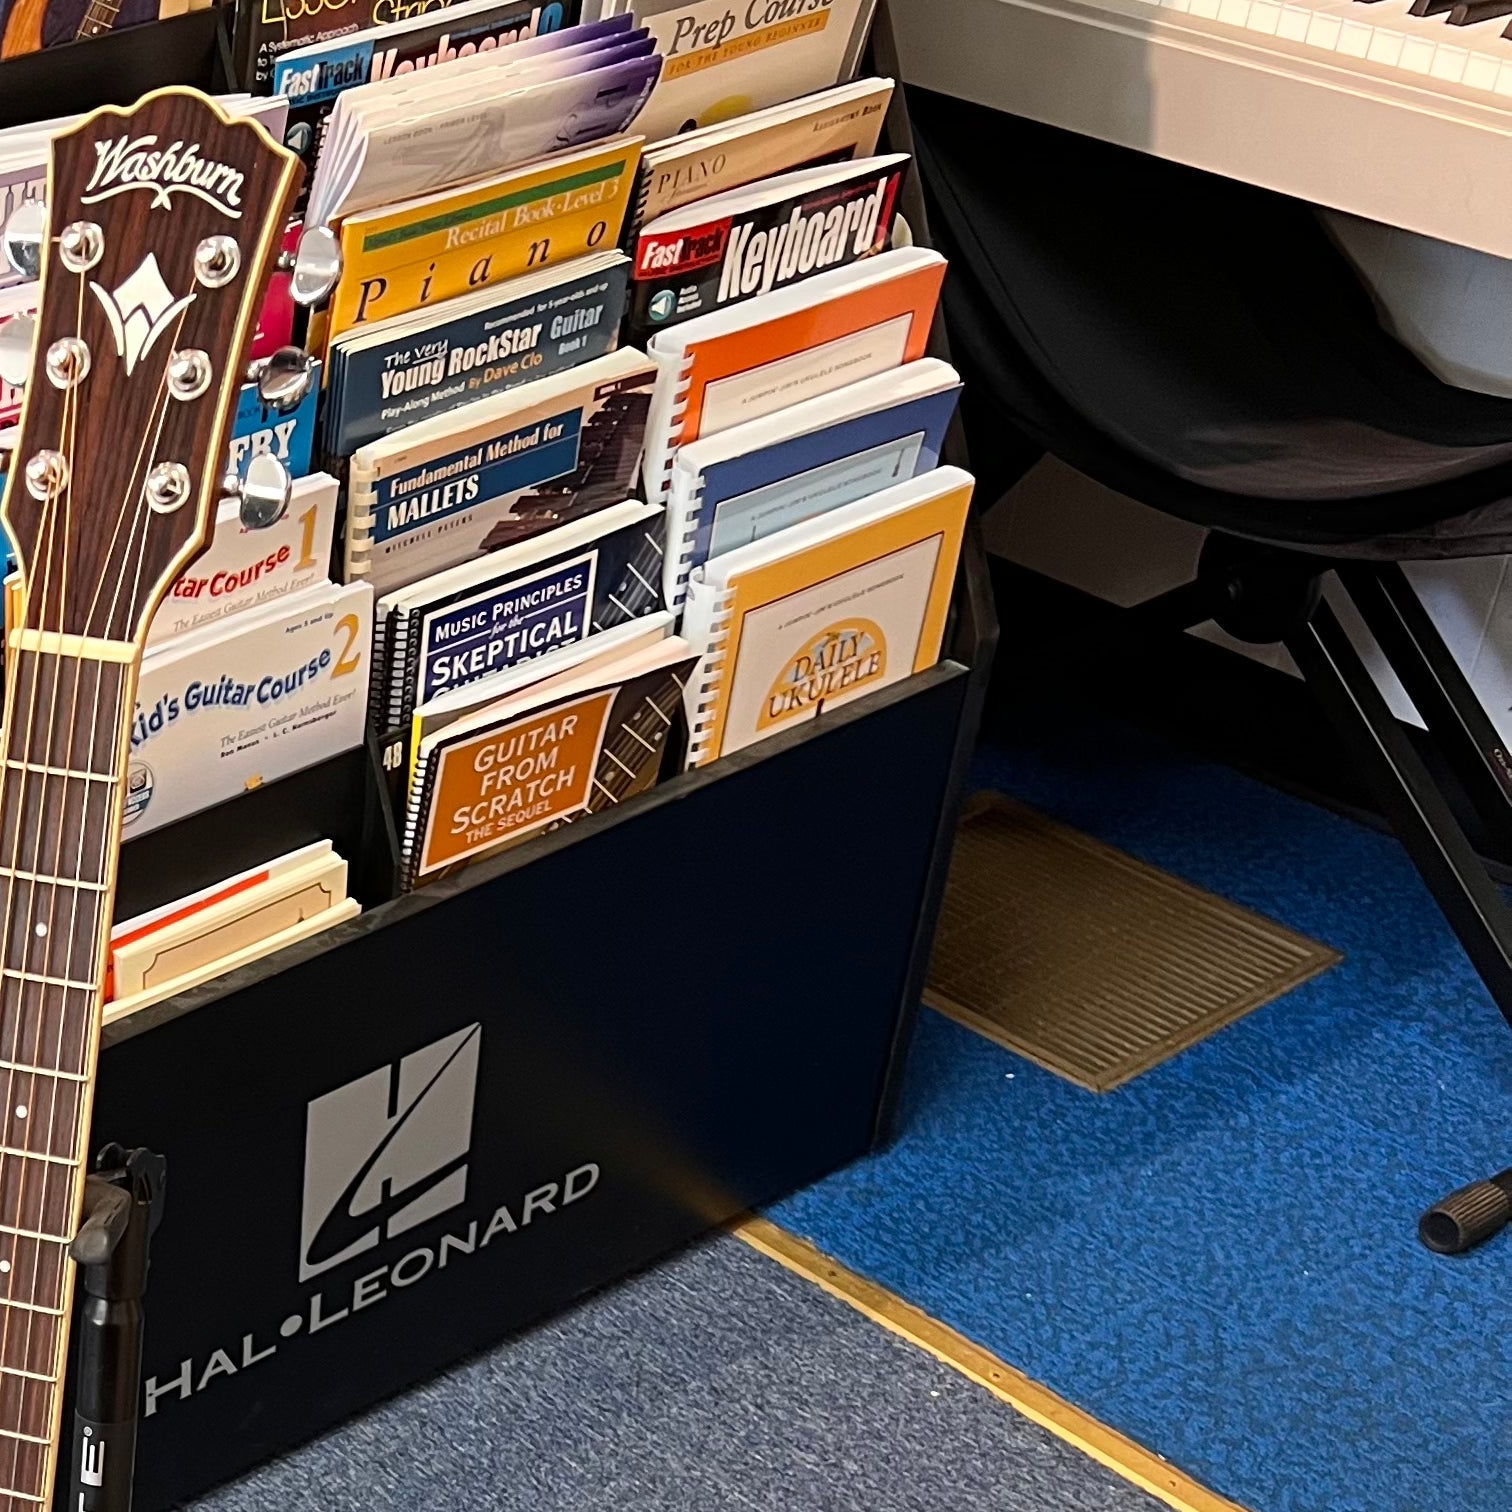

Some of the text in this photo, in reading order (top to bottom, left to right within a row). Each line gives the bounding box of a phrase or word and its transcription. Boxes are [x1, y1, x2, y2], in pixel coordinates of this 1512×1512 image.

[316, 23, 359, 42] Approach
[666, 9, 736, 56] Prep
[669, 17, 822, 75] FOR THE YOUNG BEGINNER
[85, 135, 244, 206] Washburn
[657, 153, 726, 194] PIANO
[445, 217, 507, 250] Recital
[717, 176, 888, 304] Keyboard
[381, 359, 445, 399] Young
[448, 321, 543, 377] RockStar
[550, 304, 604, 340] Guitar
[384, 339, 448, 368] The very
[431, 381, 465, 404] Method
[484, 362, 518, 382] Dave
[521, 353, 543, 374] Clo
[390, 421, 564, 498] Fundamental Method for
[387, 474, 480, 531] MALLETS
[209, 544, 291, 598] Course
[292, 503, 318, 572] 1
[173, 619, 191, 634] The
[435, 573, 583, 643] MUSIC PRINCIPLES
[490, 621, 505, 640] for
[184, 674, 255, 712] Guitar
[256, 648, 332, 704] Course
[329, 613, 362, 680] 2
[431, 610, 578, 687] SKEPTICAL
[792, 631, 864, 682] DAILY
[769, 651, 881, 718] UKULELE
[220, 735, 236, 748] The
[298, 700, 331, 720] Method
[473, 714, 578, 773] GUITAR
[480, 745, 560, 797] FROM
[450, 765, 576, 835] SCRATCH
[465, 802, 552, 844] THE SEQUEL
